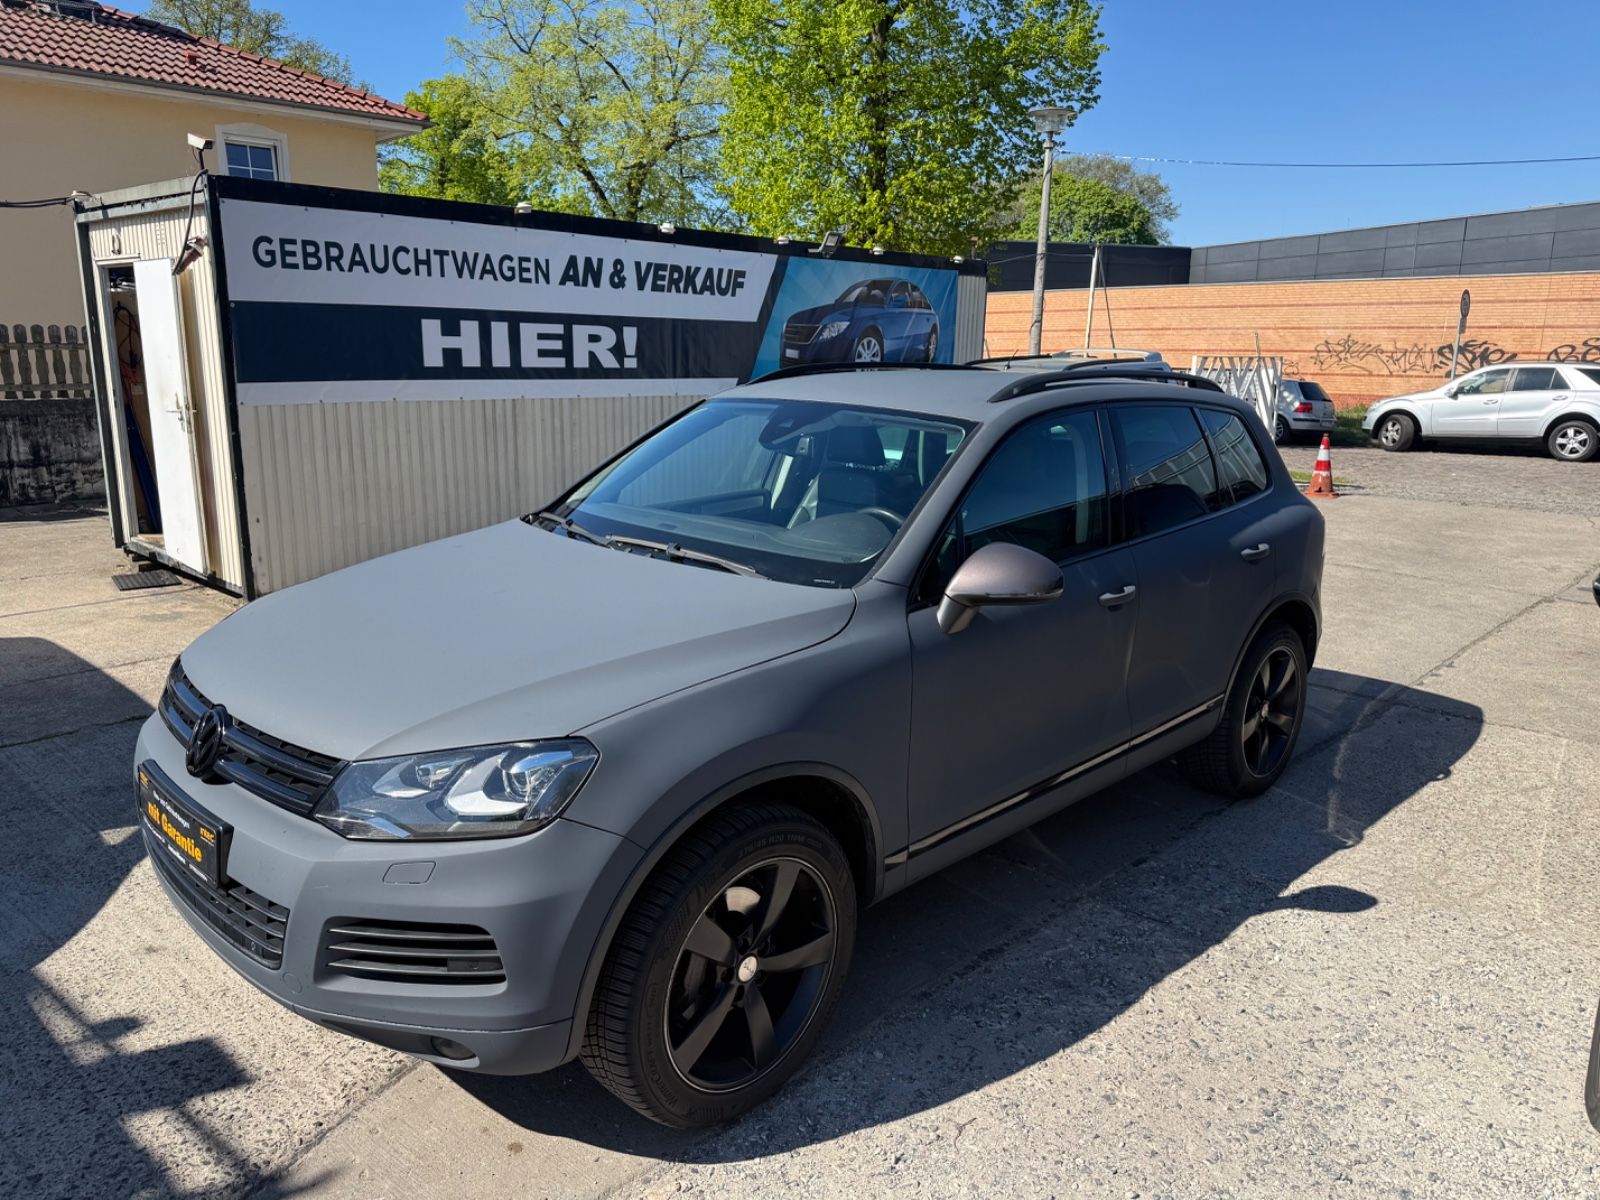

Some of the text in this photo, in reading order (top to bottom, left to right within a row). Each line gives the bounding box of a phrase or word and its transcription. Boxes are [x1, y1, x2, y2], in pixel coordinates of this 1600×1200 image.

[252, 235, 747, 297] GEBRAUCHTWAGEN AN & VERKAUF
[421, 318, 638, 369] HIER!
[148, 801, 160, 825] mit
[161, 813, 203, 862] Garantie
